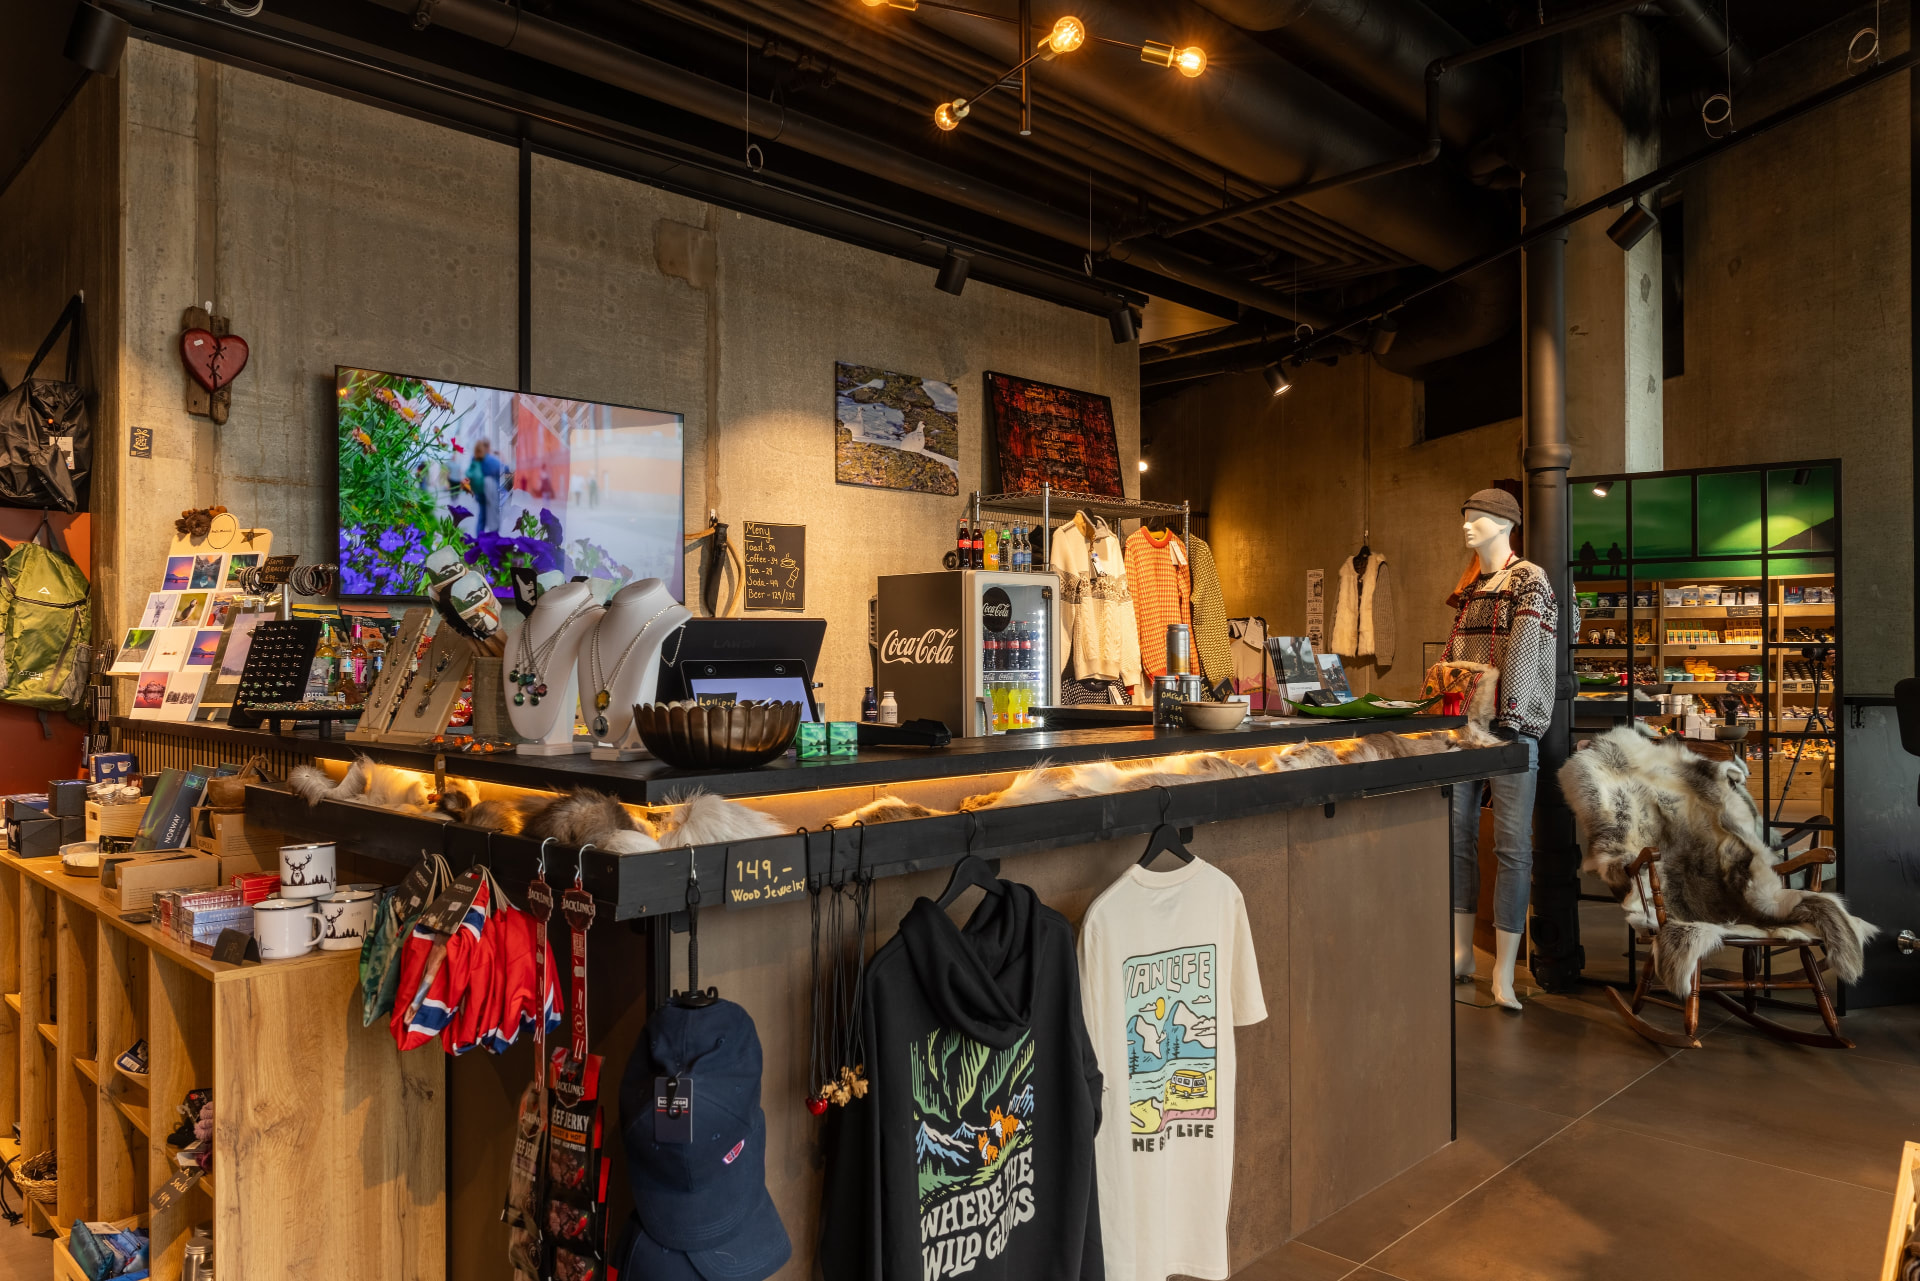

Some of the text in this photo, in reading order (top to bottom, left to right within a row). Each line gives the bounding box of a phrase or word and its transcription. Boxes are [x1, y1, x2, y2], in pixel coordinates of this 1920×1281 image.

[745, 523, 771, 544] Meny
[744, 540, 764, 552] Toast
[745, 553, 767, 563] Coffee
[746, 564, 760, 574] Tea
[746, 576, 766, 587] Soda
[748, 588, 766, 599] Beer
[982, 602, 1010, 617] Coca-Cola
[880, 628, 959, 665] Coca-Cola
[164, 813, 181, 844] NORWAY
[564, 1112, 590, 1132] JERKY
[920, 1146, 1035, 1243] WHERE THE
[922, 1231, 982, 1281] WILD
